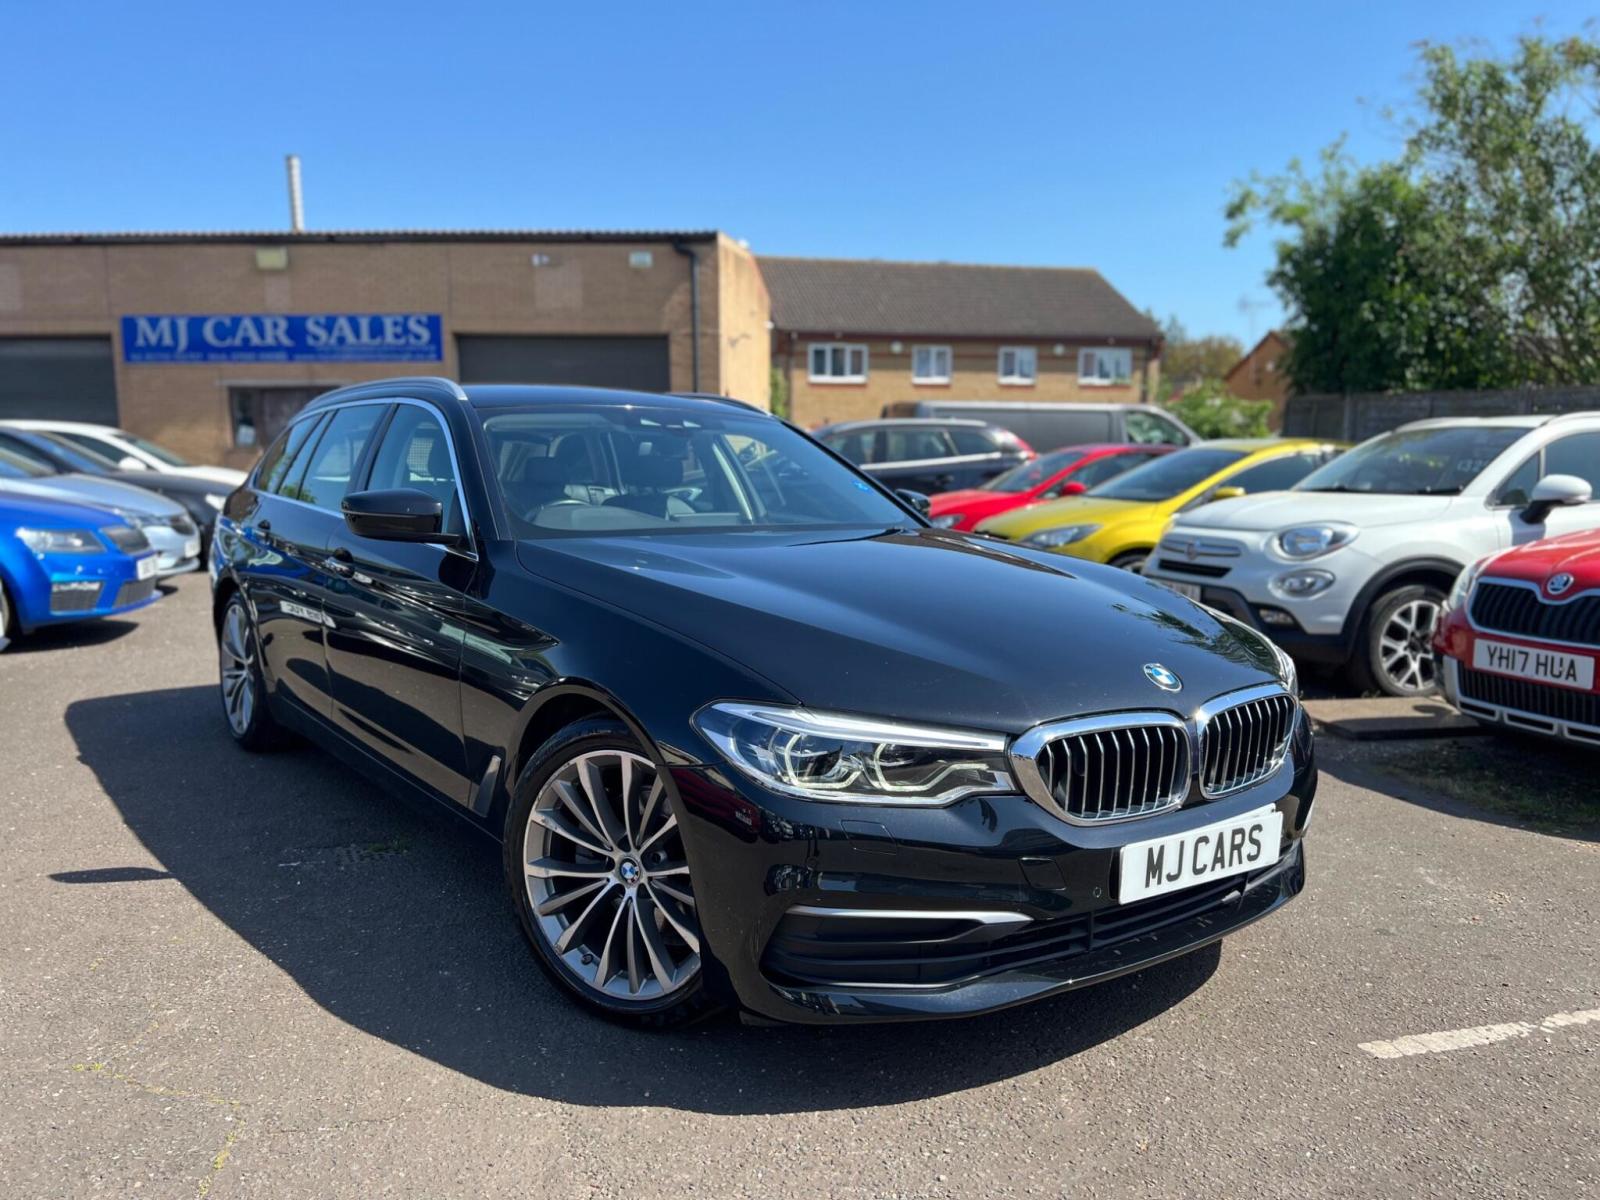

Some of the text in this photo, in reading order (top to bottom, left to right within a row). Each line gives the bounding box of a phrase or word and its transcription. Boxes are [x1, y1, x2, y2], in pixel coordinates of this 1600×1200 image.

[134, 316, 431, 351] MJ CAR SALES
[1487, 645, 1577, 682] YH17 HUA
